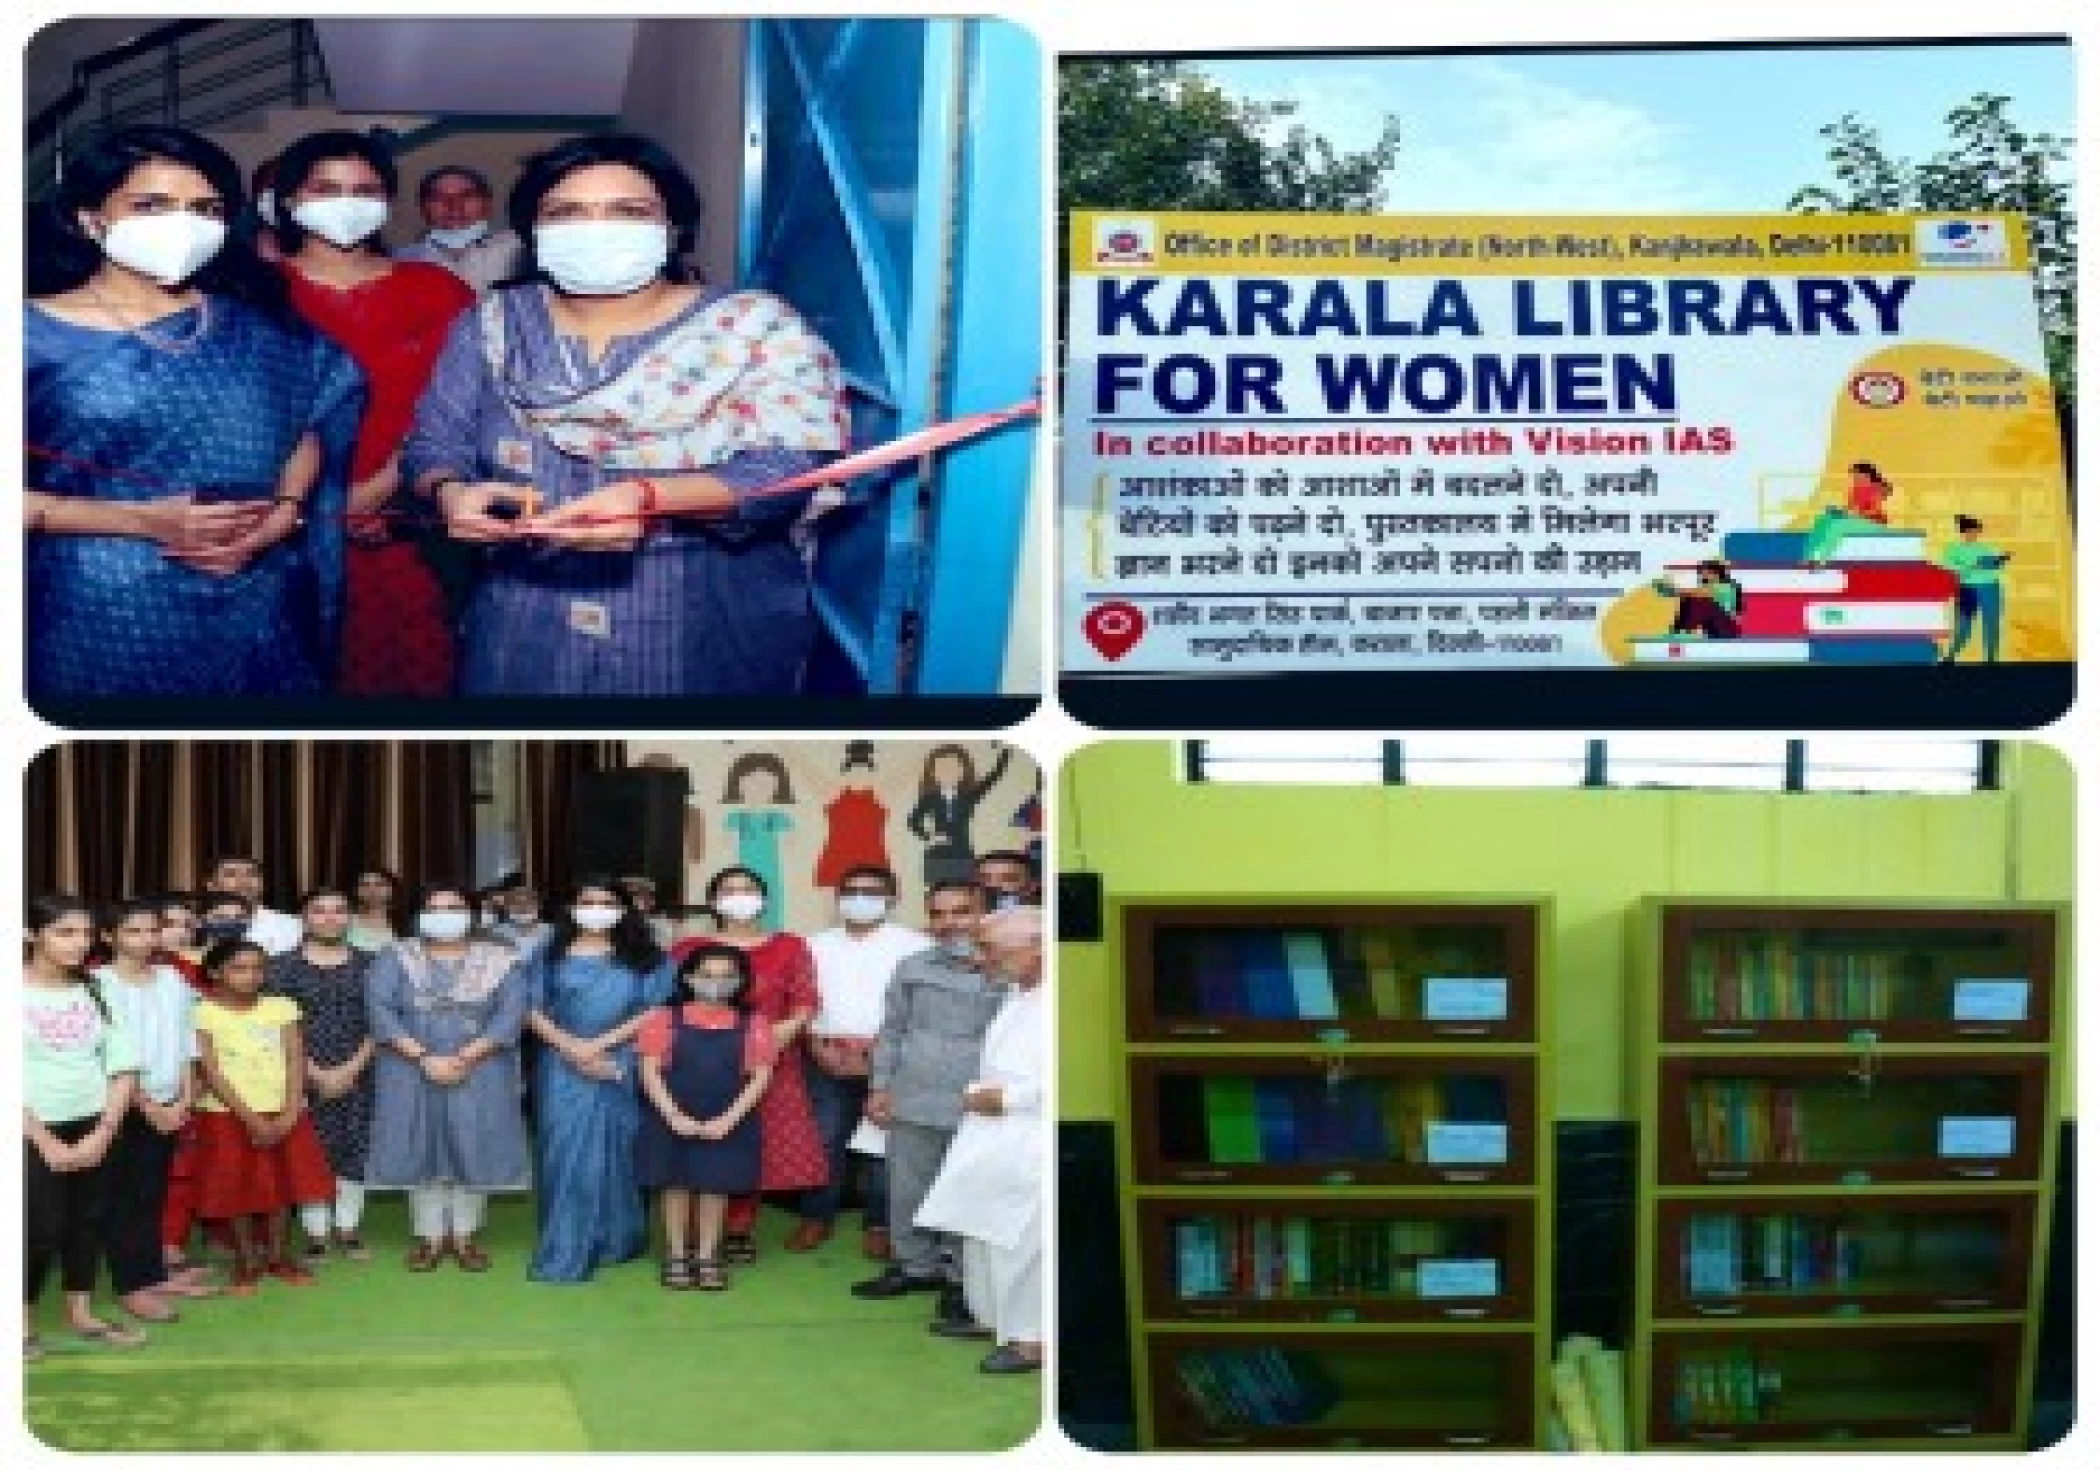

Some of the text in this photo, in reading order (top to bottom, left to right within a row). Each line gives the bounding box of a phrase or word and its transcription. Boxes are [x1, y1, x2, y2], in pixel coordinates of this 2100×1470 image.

[1165, 231, 1232, 257] Office
[1238, 232, 1260, 257] of
[1266, 232, 1350, 257] District
[1355, 232, 1469, 262] Magistrate
[1098, 279, 1916, 336] KARALA LIBRARY
[1098, 354, 1676, 414] FOR WOMEN
[1096, 427, 1733, 456] In collaboration with Vision IAS
[1254, 466, 1289, 497] को
[1445, 466, 1524, 496] बदलने
[1584, 466, 1659, 496] अपनी
[1206, 505, 1239, 535] को
[1373, 544, 1440, 575] अपने
[1533, 543, 1569, 574] की
